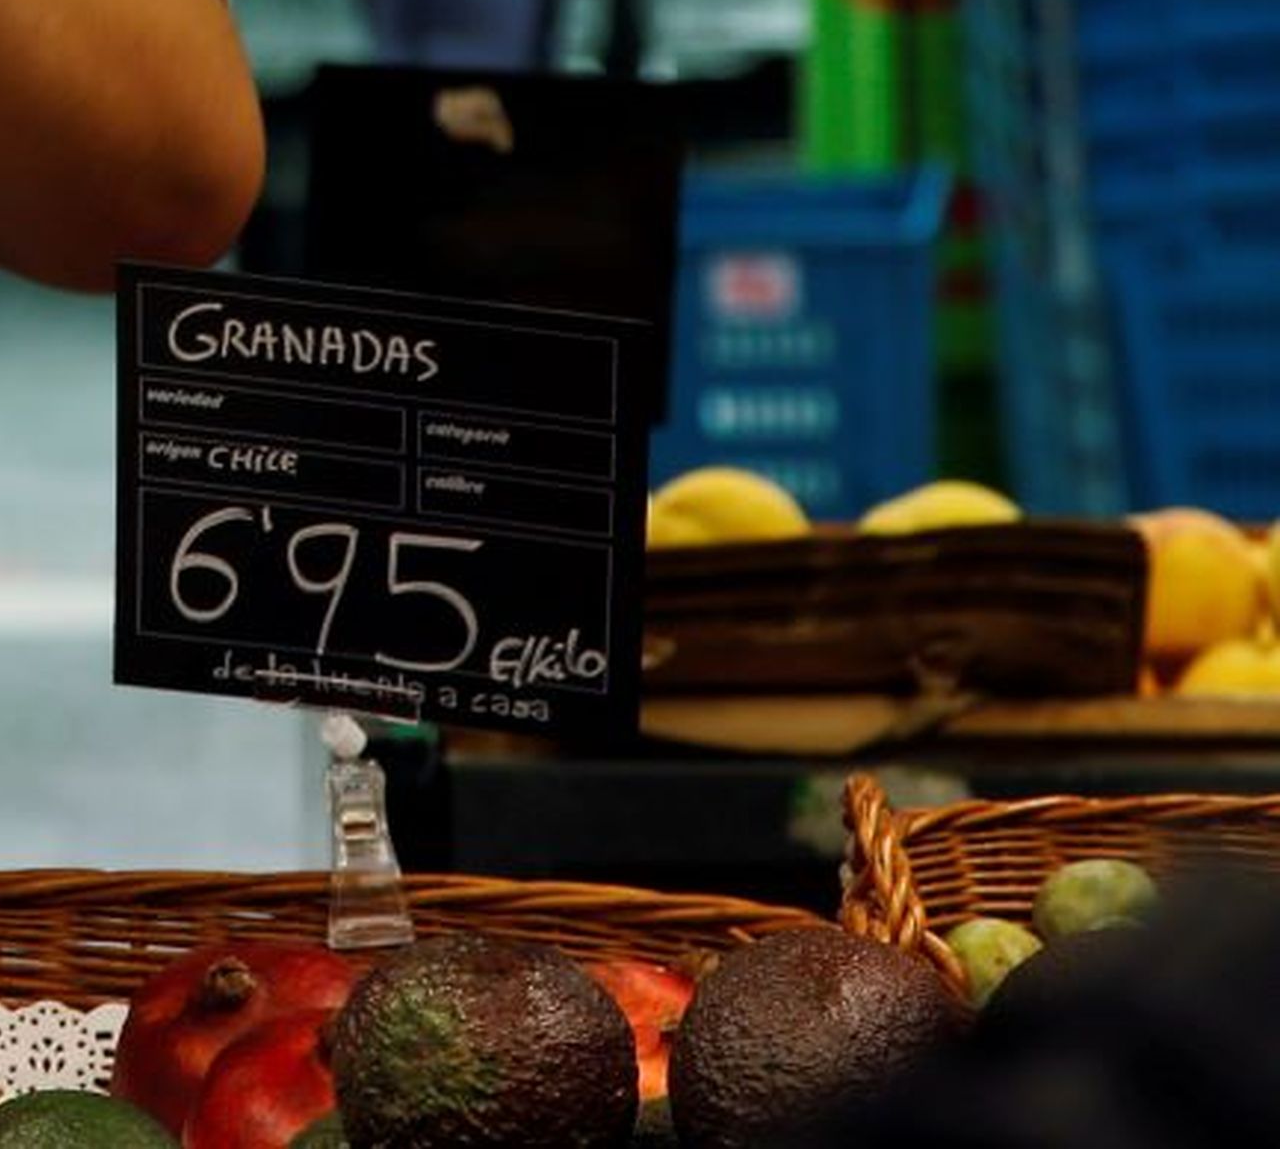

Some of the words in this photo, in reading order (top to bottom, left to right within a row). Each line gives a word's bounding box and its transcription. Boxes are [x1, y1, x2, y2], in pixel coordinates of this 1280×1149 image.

[168, 303, 439, 382] GRANADAS
[144, 440, 203, 462] origen
[170, 506, 484, 672] 6'95
[471, 694, 551, 723] casa
